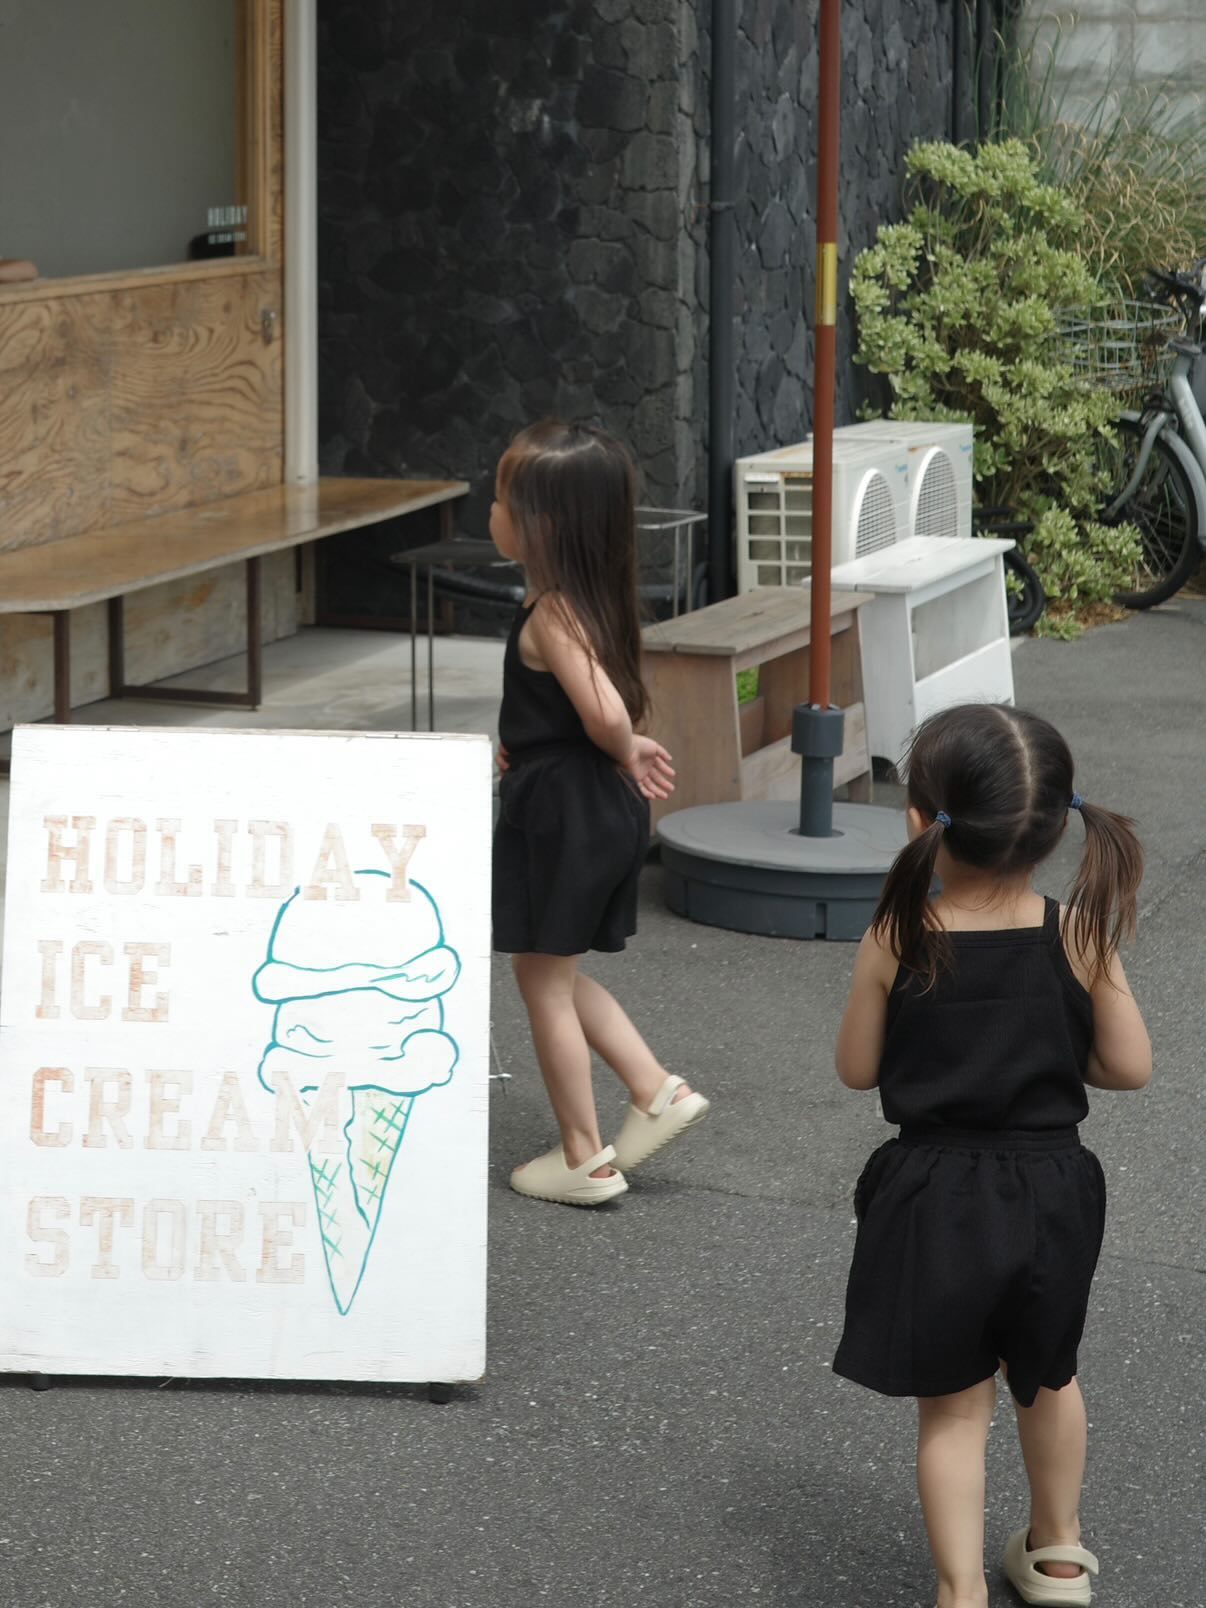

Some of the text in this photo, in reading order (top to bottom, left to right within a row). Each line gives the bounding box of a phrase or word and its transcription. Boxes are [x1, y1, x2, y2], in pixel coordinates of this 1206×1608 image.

[40, 815, 427, 902] HOLIDAY
[36, 940, 171, 1022] ICE
[29, 1067, 346, 1153] CREAM
[25, 1196, 306, 1284] STORE
